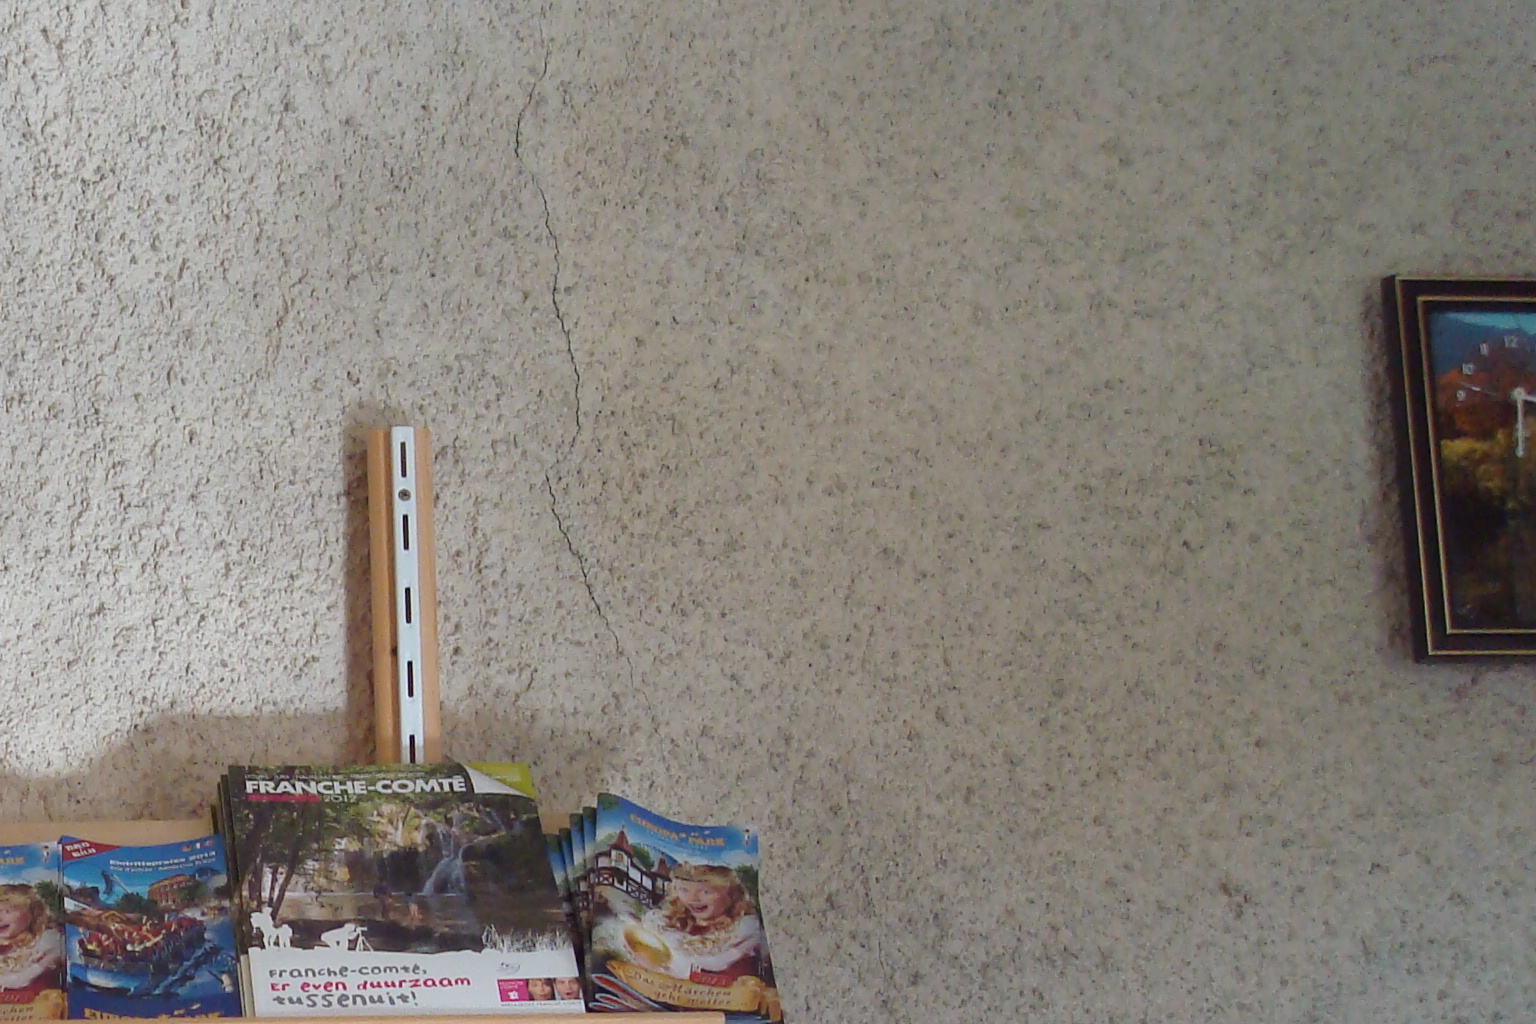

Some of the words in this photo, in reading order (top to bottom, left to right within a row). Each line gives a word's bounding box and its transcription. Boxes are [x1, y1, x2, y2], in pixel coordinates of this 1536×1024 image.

[245, 775, 467, 795] FRANCHE-COMTÉ
[301, 980, 348, 993] even
[357, 976, 472, 992] duurzaam
[272, 990, 418, 1008] tussenuit!
